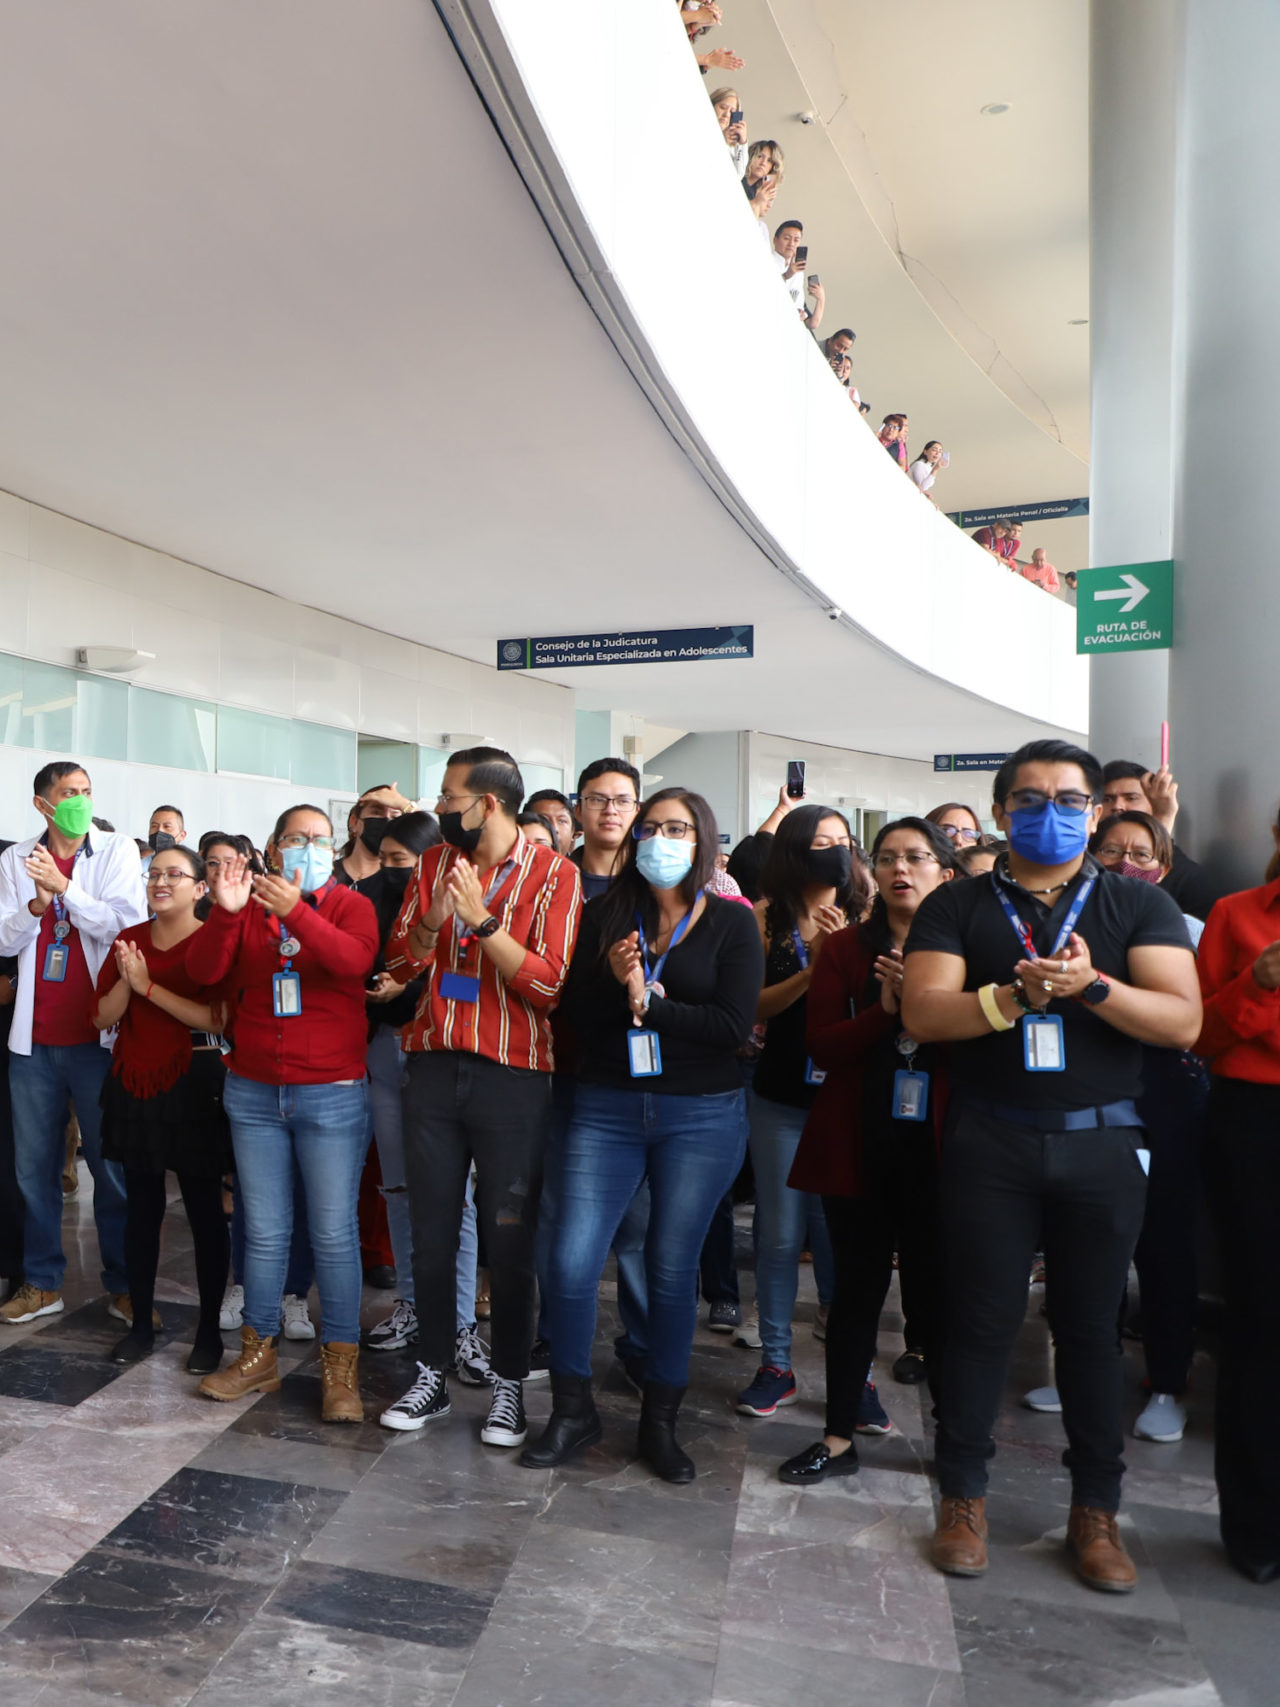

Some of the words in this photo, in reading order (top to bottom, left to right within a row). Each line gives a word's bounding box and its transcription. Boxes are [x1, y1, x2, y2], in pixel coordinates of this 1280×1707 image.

[1096, 622, 1128, 633] RUTA
[1131, 620, 1147, 630] DE
[535, 641, 575, 651] Consejo
[577, 640, 590, 649] de
[592, 639, 601, 648] la
[603, 637, 658, 648] Judicatura
[1083, 629, 1161, 645] EVACUACIÓN
[535, 655, 555, 664] Sala
[557, 652, 594, 663] Unitaria
[596, 649, 661, 661] Especializada
[663, 649, 677, 657] en
[678, 645, 748, 656] Adolescentes
